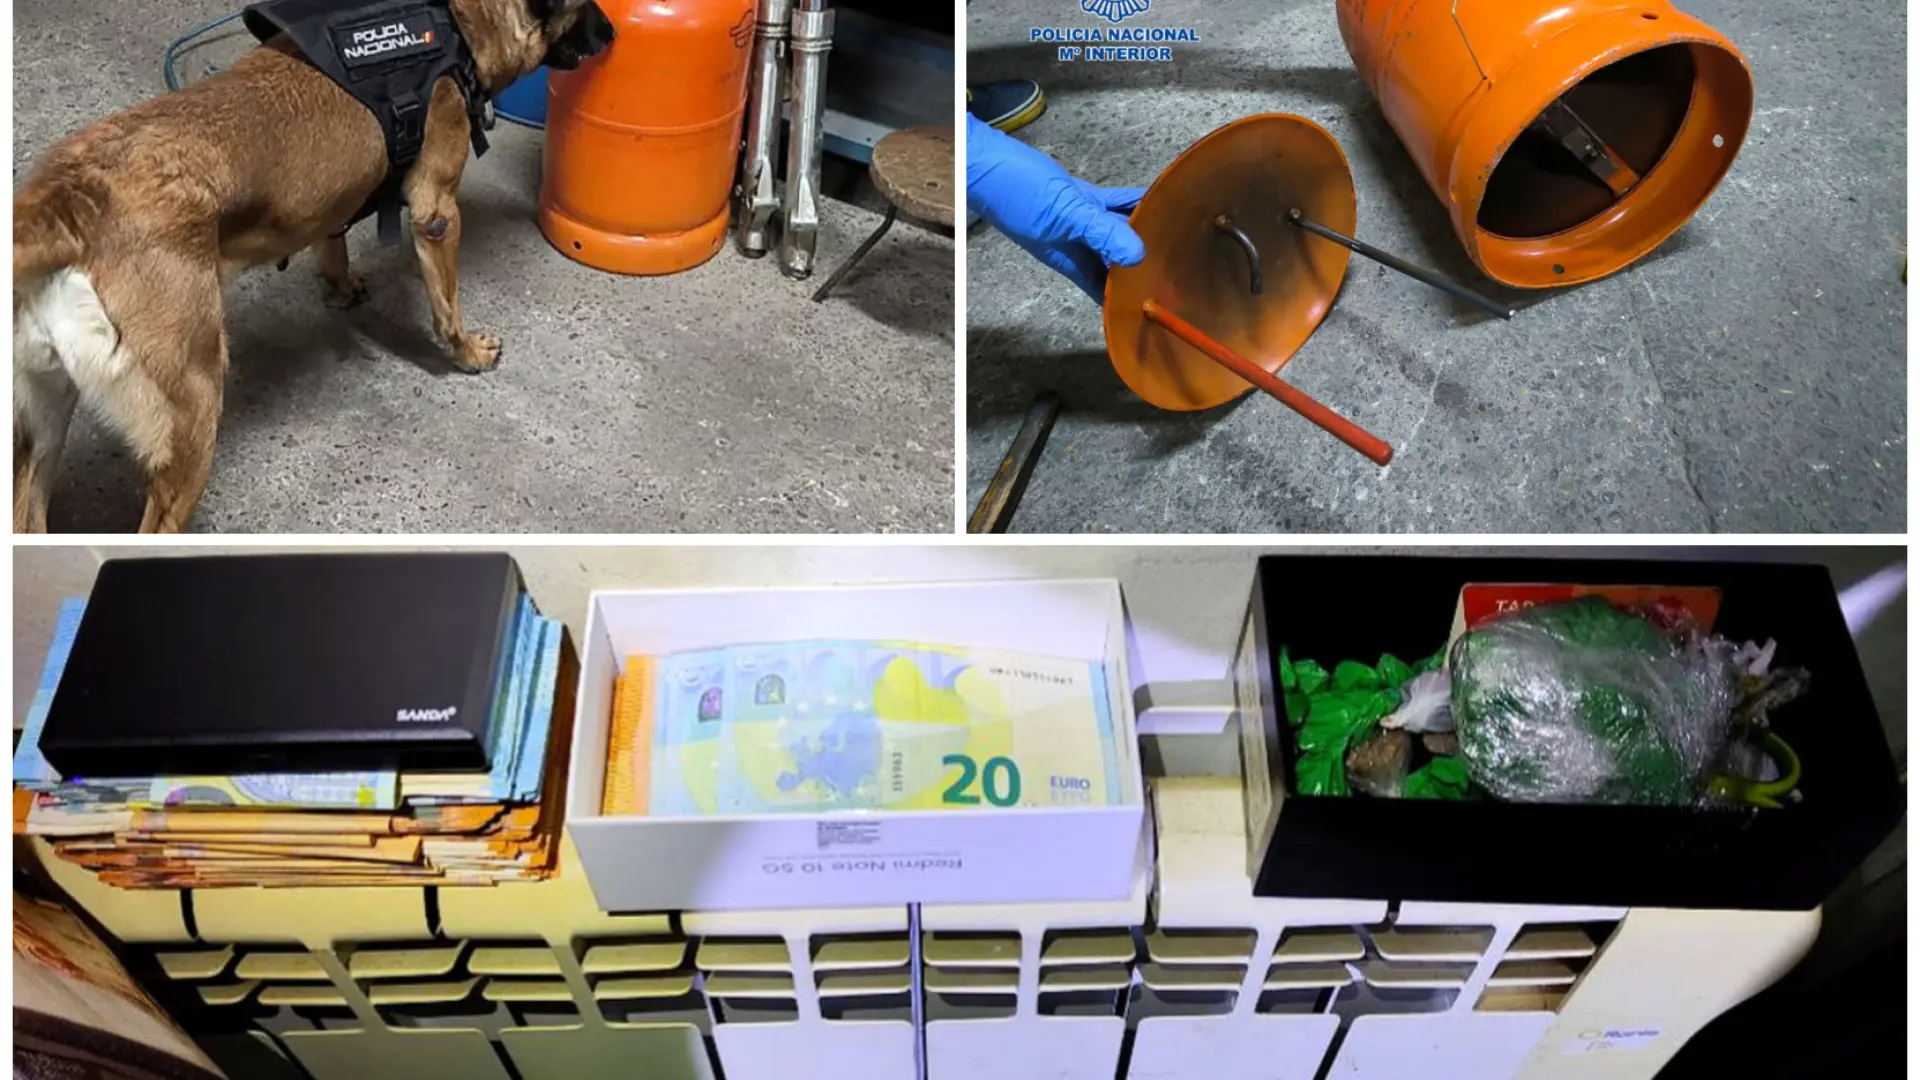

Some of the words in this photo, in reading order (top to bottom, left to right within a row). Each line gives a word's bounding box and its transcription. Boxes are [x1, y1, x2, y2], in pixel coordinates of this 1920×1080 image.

[344, 33, 425, 58] NACIONAL
[942, 754, 1021, 808] 20
[1049, 775, 1091, 790] EURO
[761, 862, 794, 875] 5G
[801, 861, 823, 874] 10
[832, 860, 886, 873] Note
[893, 858, 963, 872] Redmi
